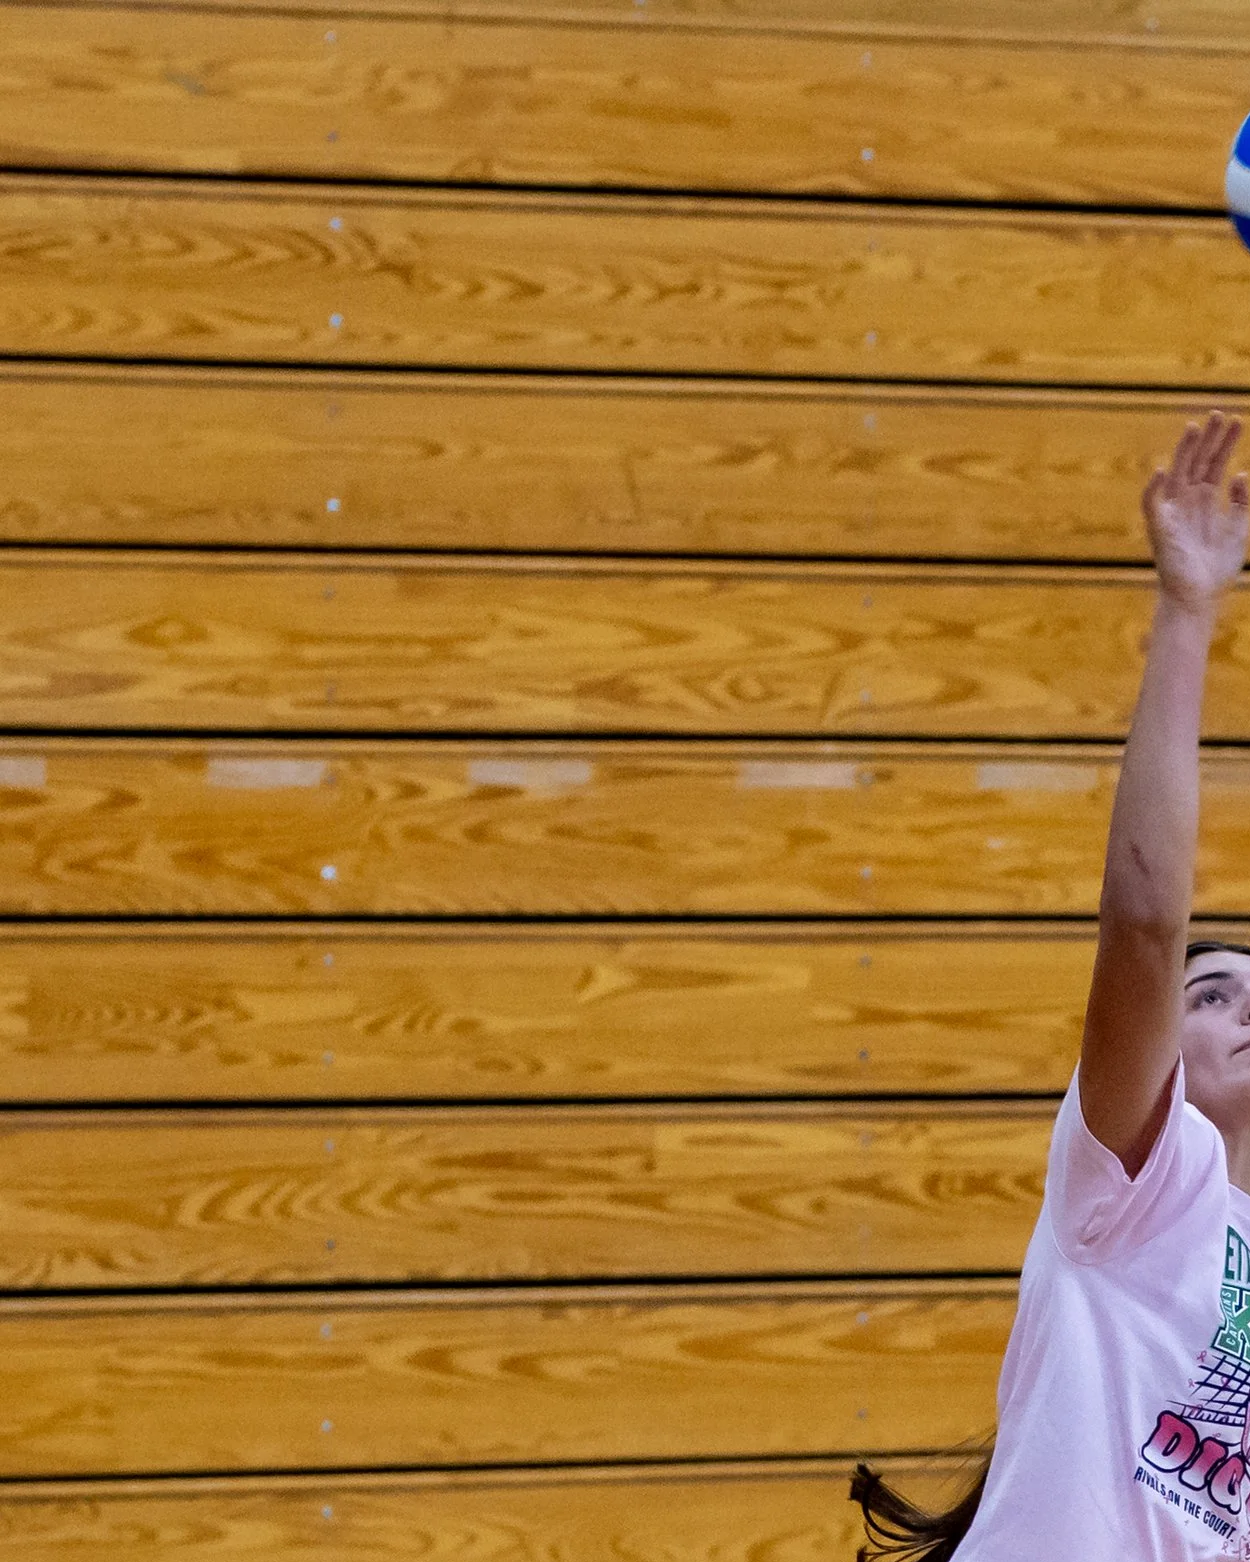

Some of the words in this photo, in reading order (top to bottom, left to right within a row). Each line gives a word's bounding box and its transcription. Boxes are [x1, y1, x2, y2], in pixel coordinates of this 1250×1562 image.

[1133, 1466, 1166, 1497] RIVALS
[1167, 1489, 1181, 1507] ON
[1183, 1497, 1202, 1520] THE
